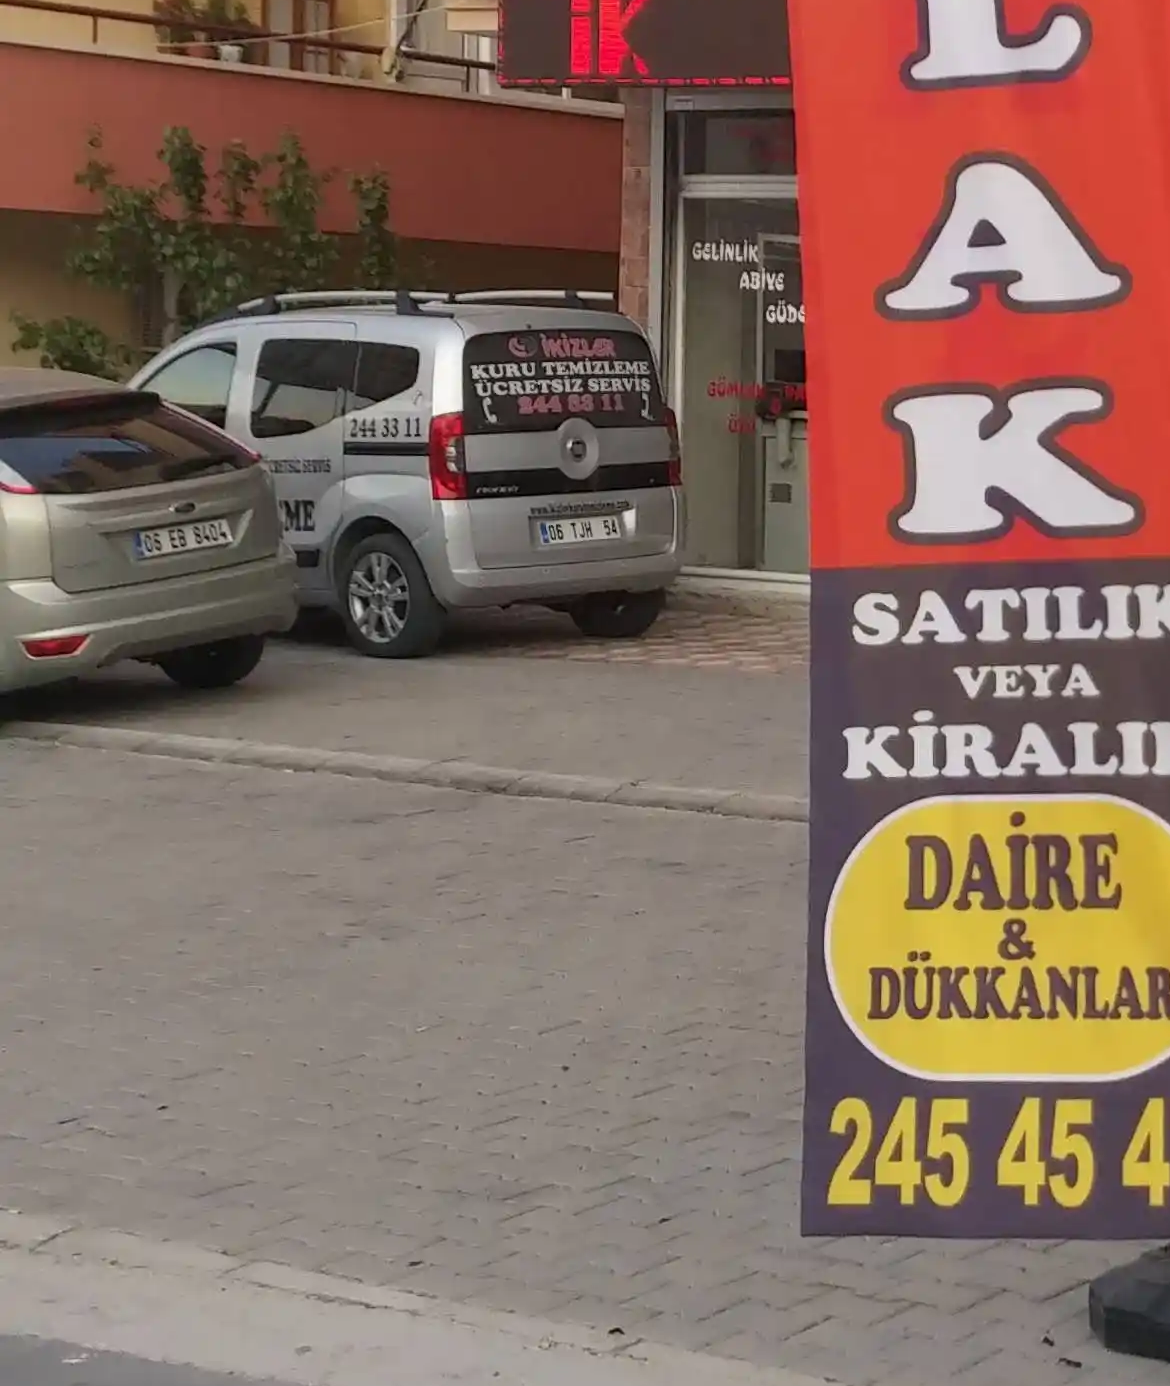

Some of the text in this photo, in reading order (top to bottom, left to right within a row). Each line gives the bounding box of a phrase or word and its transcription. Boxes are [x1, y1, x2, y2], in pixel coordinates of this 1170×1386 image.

[692, 239, 760, 263] GELİNLİK
[739, 268, 785, 291] ABİYE
[470, 357, 651, 379] KURU TEMİZLEME
[474, 374, 651, 397] ÜCRETSİZ SERVİS
[350, 416, 422, 439] 244 33 11
[549, 519, 618, 541] 06 TJH 54
[953, 664, 1100, 699] VEYA
[904, 812, 1122, 912] DAİRE
[998, 919, 1036, 961] &
[827, 1096, 970, 1207] 245
[997, 1097, 1094, 1208] 45
